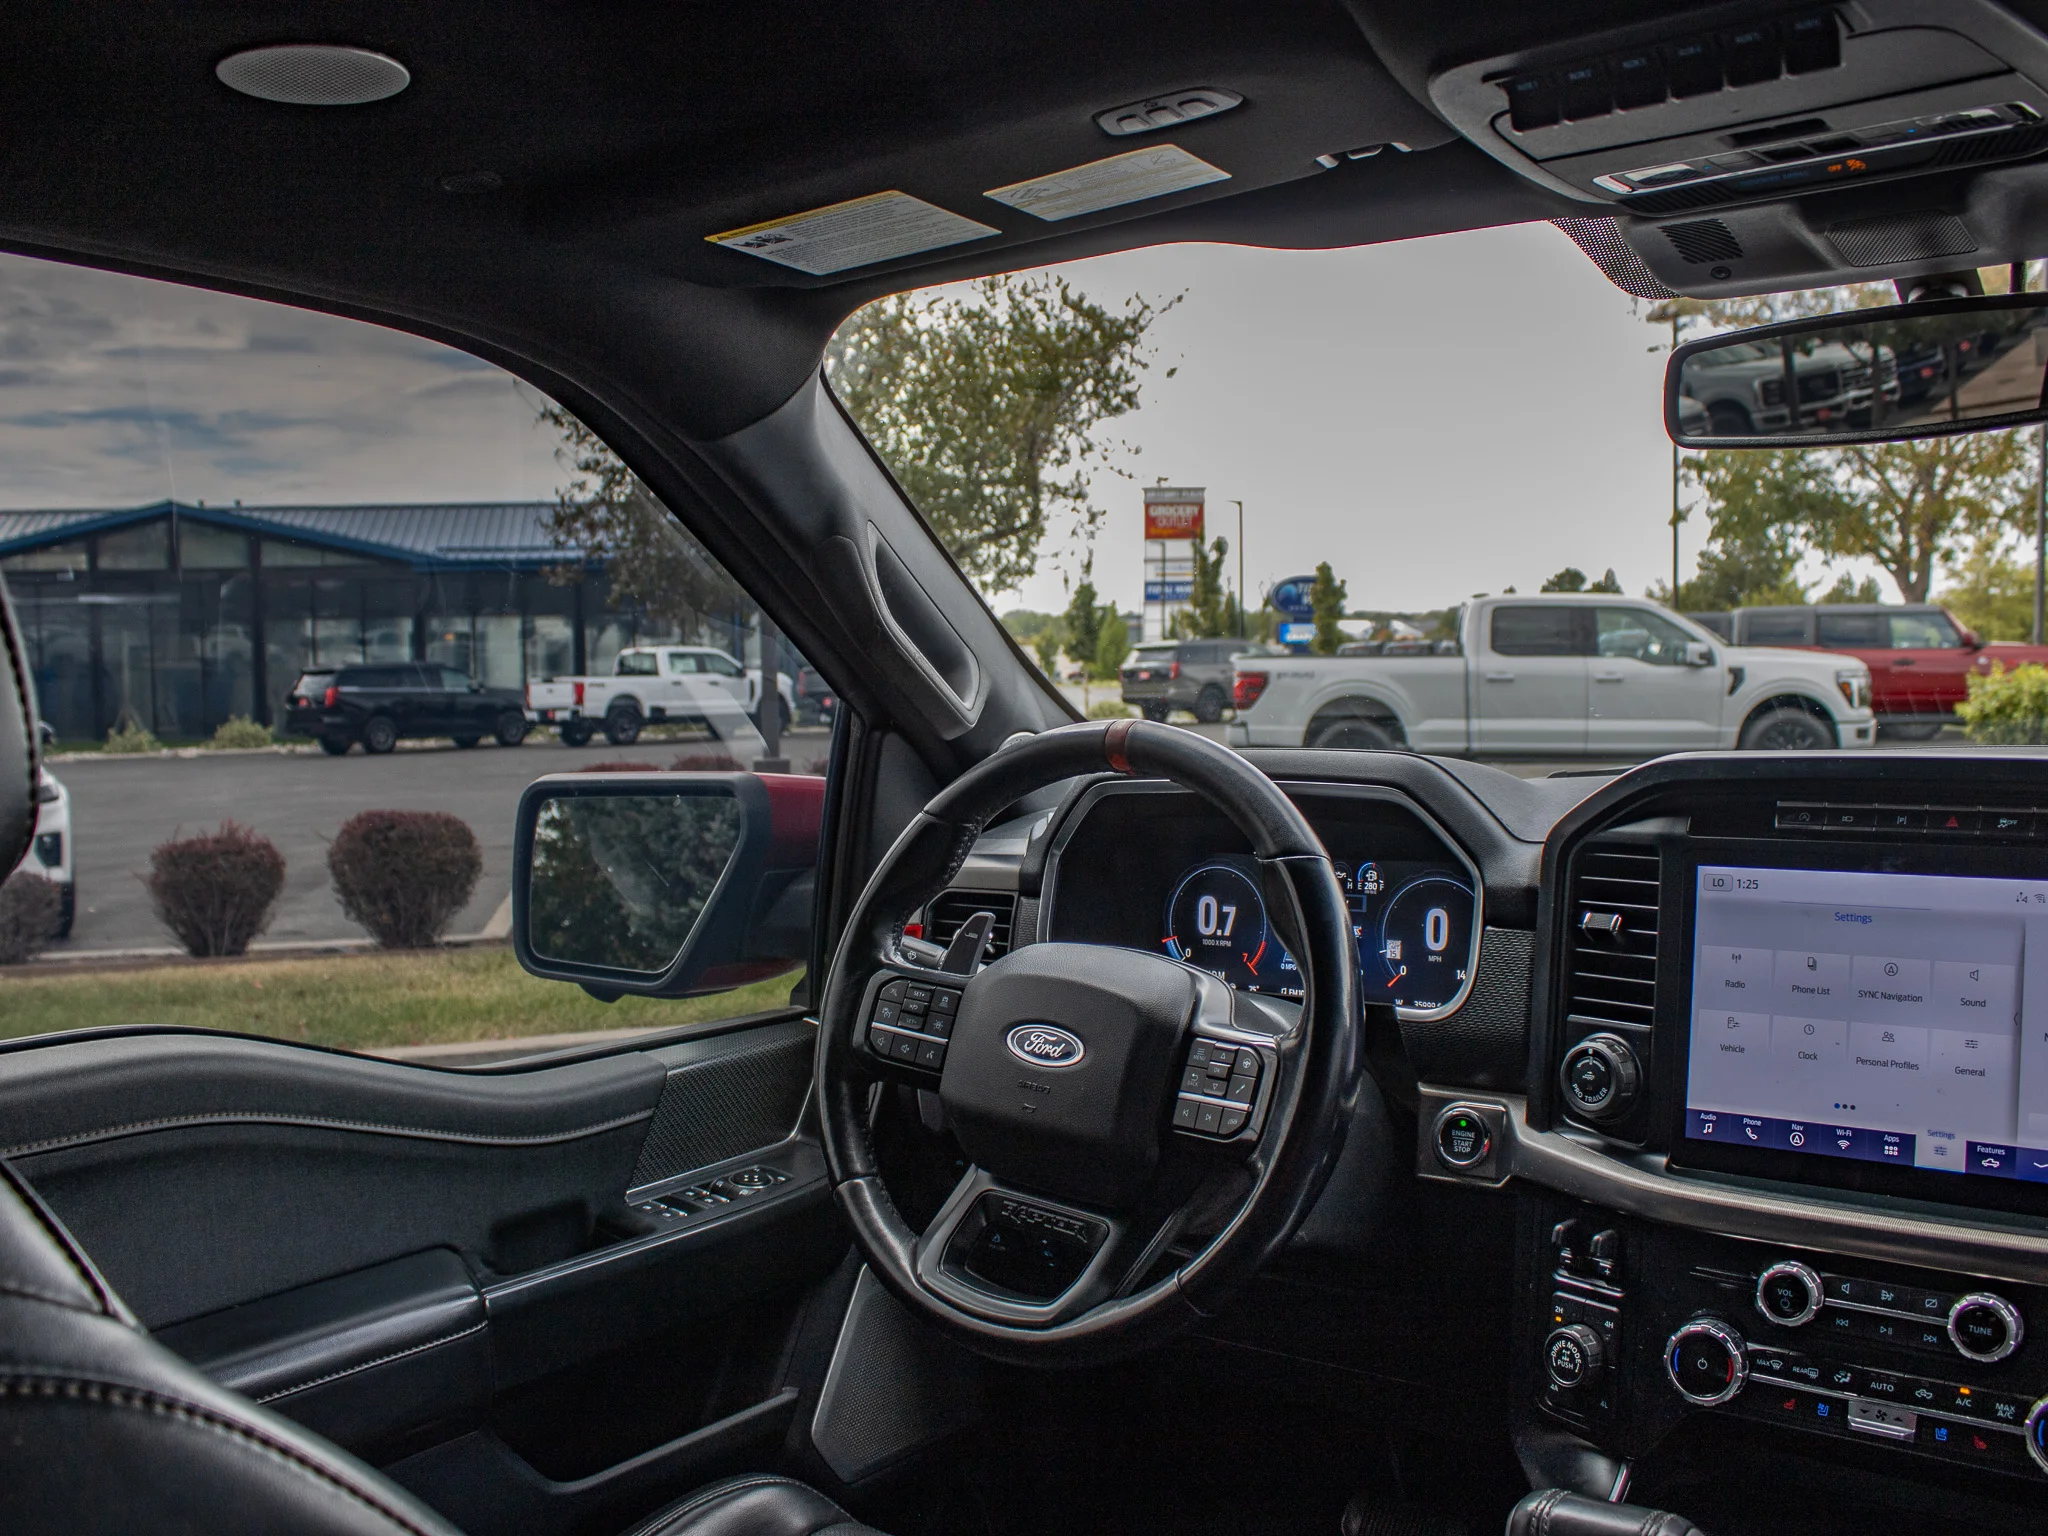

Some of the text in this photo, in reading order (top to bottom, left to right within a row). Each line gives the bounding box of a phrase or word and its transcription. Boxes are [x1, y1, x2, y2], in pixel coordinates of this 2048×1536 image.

[1148, 505, 1199, 517] GROCERY
[1155, 517, 1192, 528] OUTLET
[1364, 882, 1378, 890] 280
[1712, 878, 1725, 887] LO
[1736, 879, 1759, 890] 1:25
[1198, 895, 1237, 937] 0.7
[1834, 912, 1873, 925] Settings
[1425, 908, 1449, 952] 0
[1185, 948, 1192, 958] 0
[1242, 952, 1249, 962] 7
[1400, 965, 1407, 975] 0
[1725, 979, 1746, 989] Radio
[1791, 984, 1831, 996] Phone List
[1858, 990, 1923, 1003] SYNC Navigation
[1960, 998, 1987, 1008] Sound
[1024, 1032, 1066, 1058] Ford
[1719, 1043, 1745, 1054] Vehicle
[1797, 1050, 1818, 1061] Clock
[1855, 1057, 1920, 1071] Personal Profiles
[1954, 1066, 1986, 1077] General
[1572, 1083, 1608, 1103] PRO TRAILER
[1700, 1112, 1717, 1121] Audio
[1743, 1118, 1762, 1127] Phone
[1791, 1123, 1804, 1132] Nav
[1451, 1129, 1476, 1138] ENGINE
[1836, 1128, 1852, 1137] Wi-Fi
[1927, 1129, 1956, 1141] Settings
[1453, 1139, 1473, 1147] START
[1884, 1134, 1900, 1143] Apps
[1977, 1145, 2006, 1155] Features
[1777, 1288, 1793, 1298] VOL
[1554, 1305, 1564, 1314] 2H
[1604, 1320, 1614, 1329] 4H
[1968, 1324, 1993, 1336] TUNE
[1550, 1340, 1582, 1364] DRIVE MODE
[1557, 1359, 1574, 1370] PUSH
[1756, 1358, 1771, 1367] MAX
[1792, 1366, 1808, 1375] REAR
[1549, 1384, 1559, 1392] 4A
[1870, 1381, 1894, 1392] AUTO
[1600, 1400, 1608, 1409] 4L
[1955, 1397, 1972, 1407] A/C
[1995, 1402, 2016, 1413] MAX
[1997, 1410, 2014, 1420] A/C
